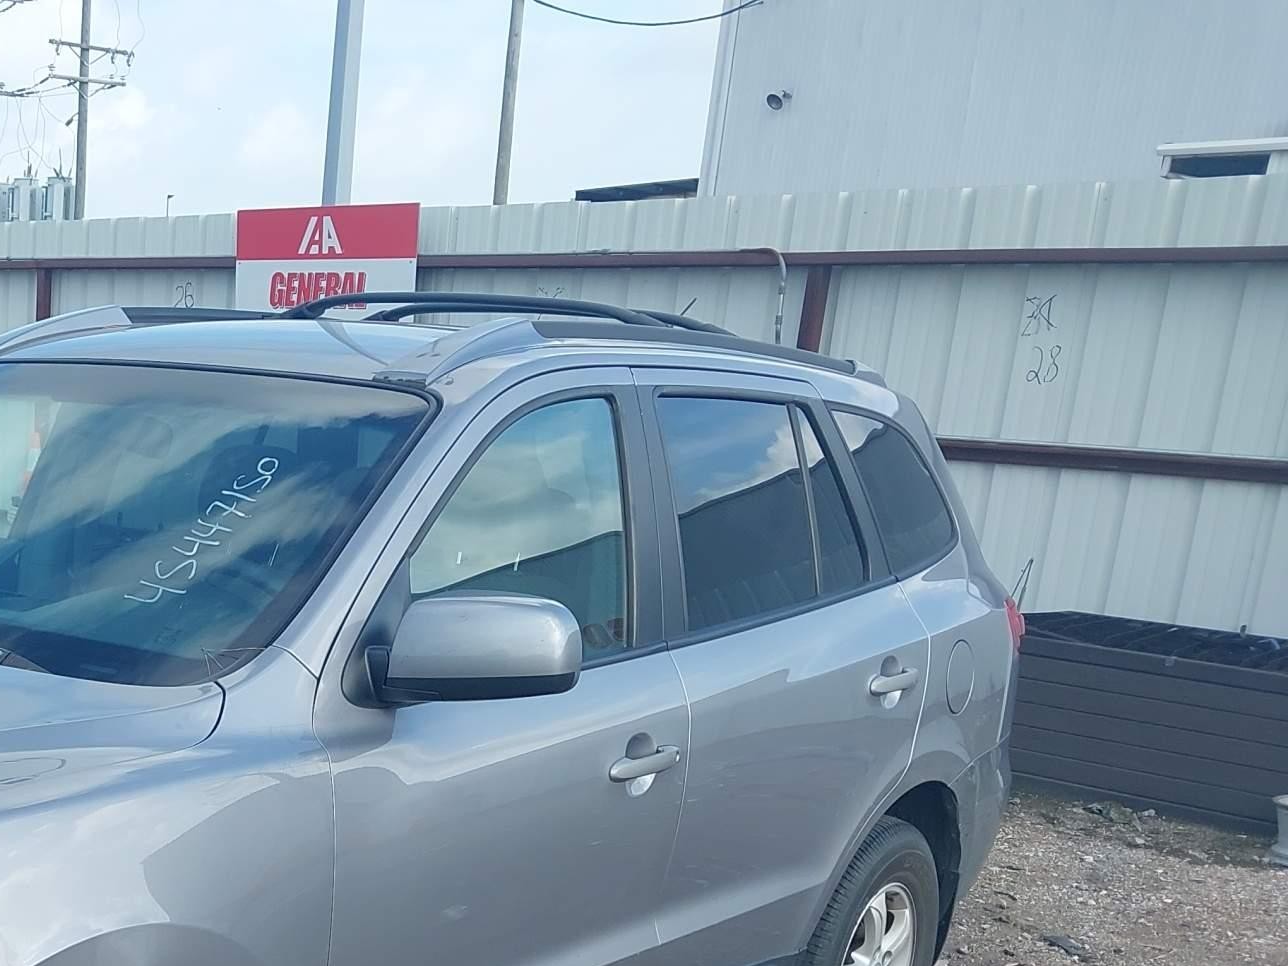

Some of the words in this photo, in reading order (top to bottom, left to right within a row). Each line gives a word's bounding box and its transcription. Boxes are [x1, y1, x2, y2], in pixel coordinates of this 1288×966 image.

[174, 279, 195, 308] 26
[269, 271, 368, 310] GENERAL
[1025, 344, 1062, 385] 28
